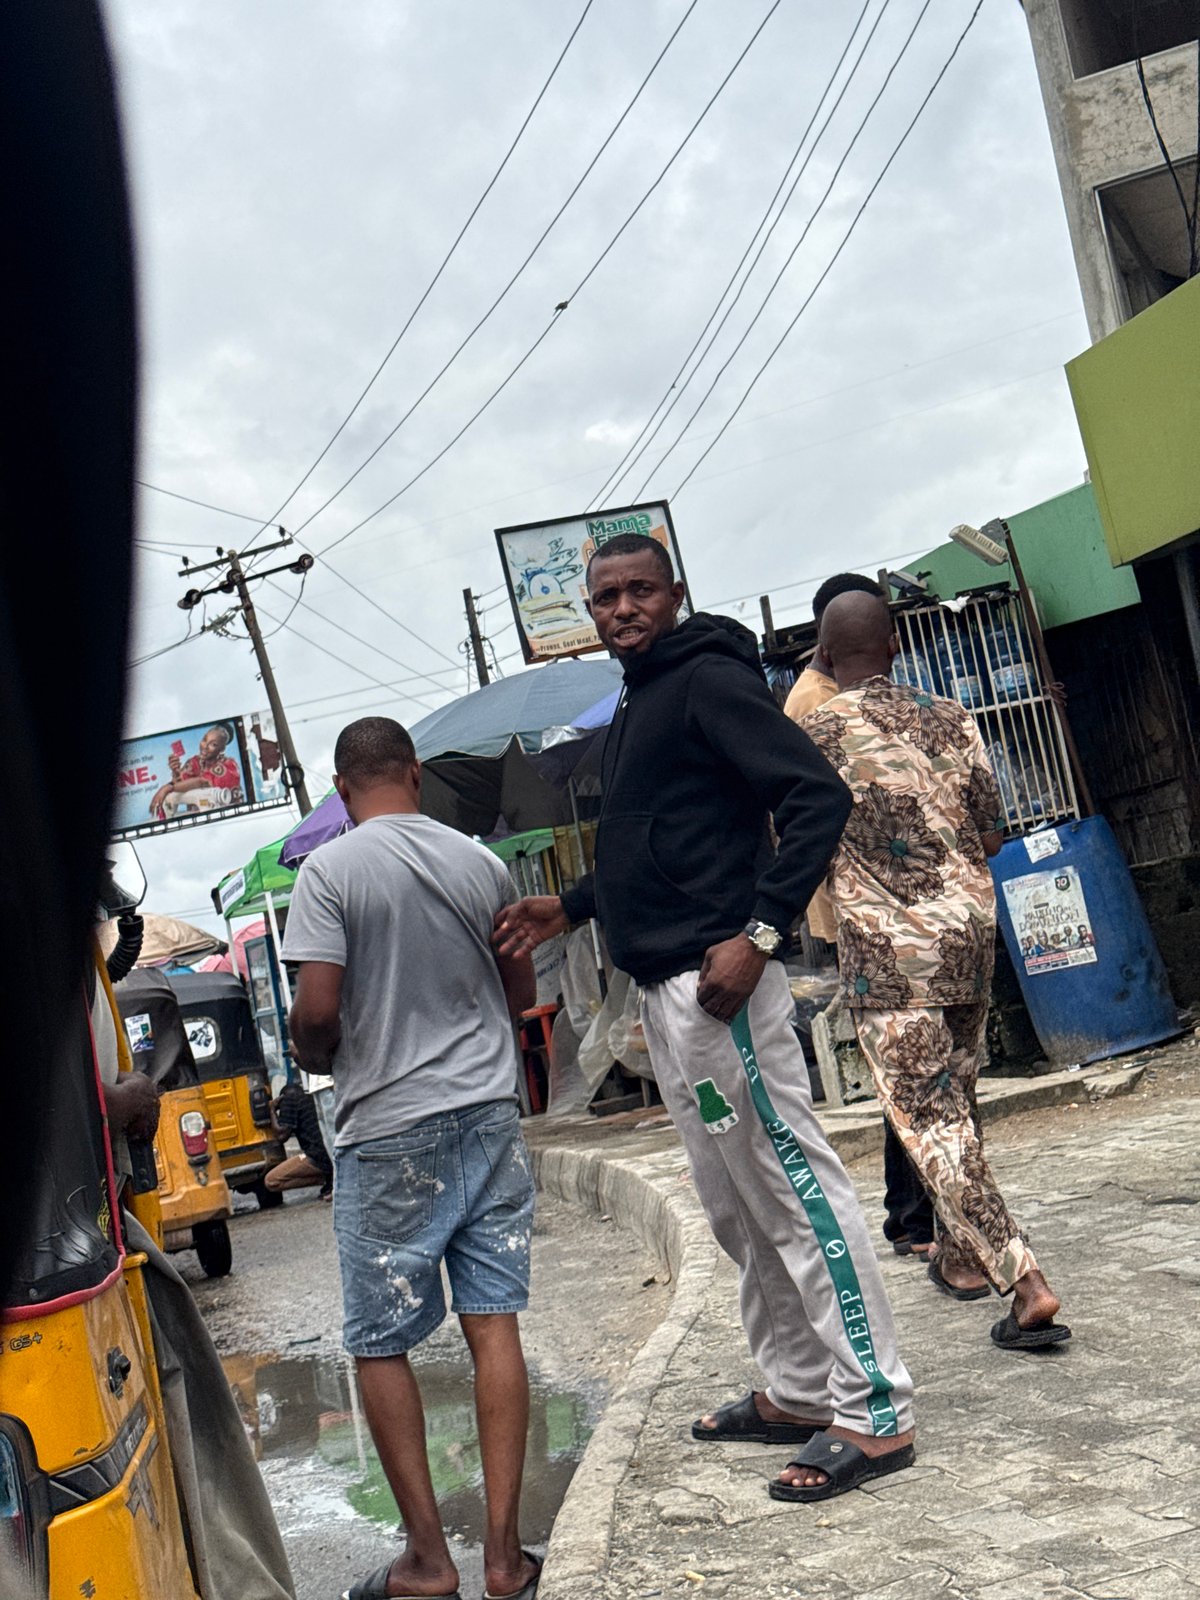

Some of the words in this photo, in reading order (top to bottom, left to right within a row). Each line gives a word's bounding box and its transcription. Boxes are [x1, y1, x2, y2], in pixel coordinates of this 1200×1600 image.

[587, 512, 651, 536] Mama
[742, 1047, 759, 1084] UP
[767, 1117, 824, 1200] AWAKE
[840, 1290, 878, 1373] SLEEP
